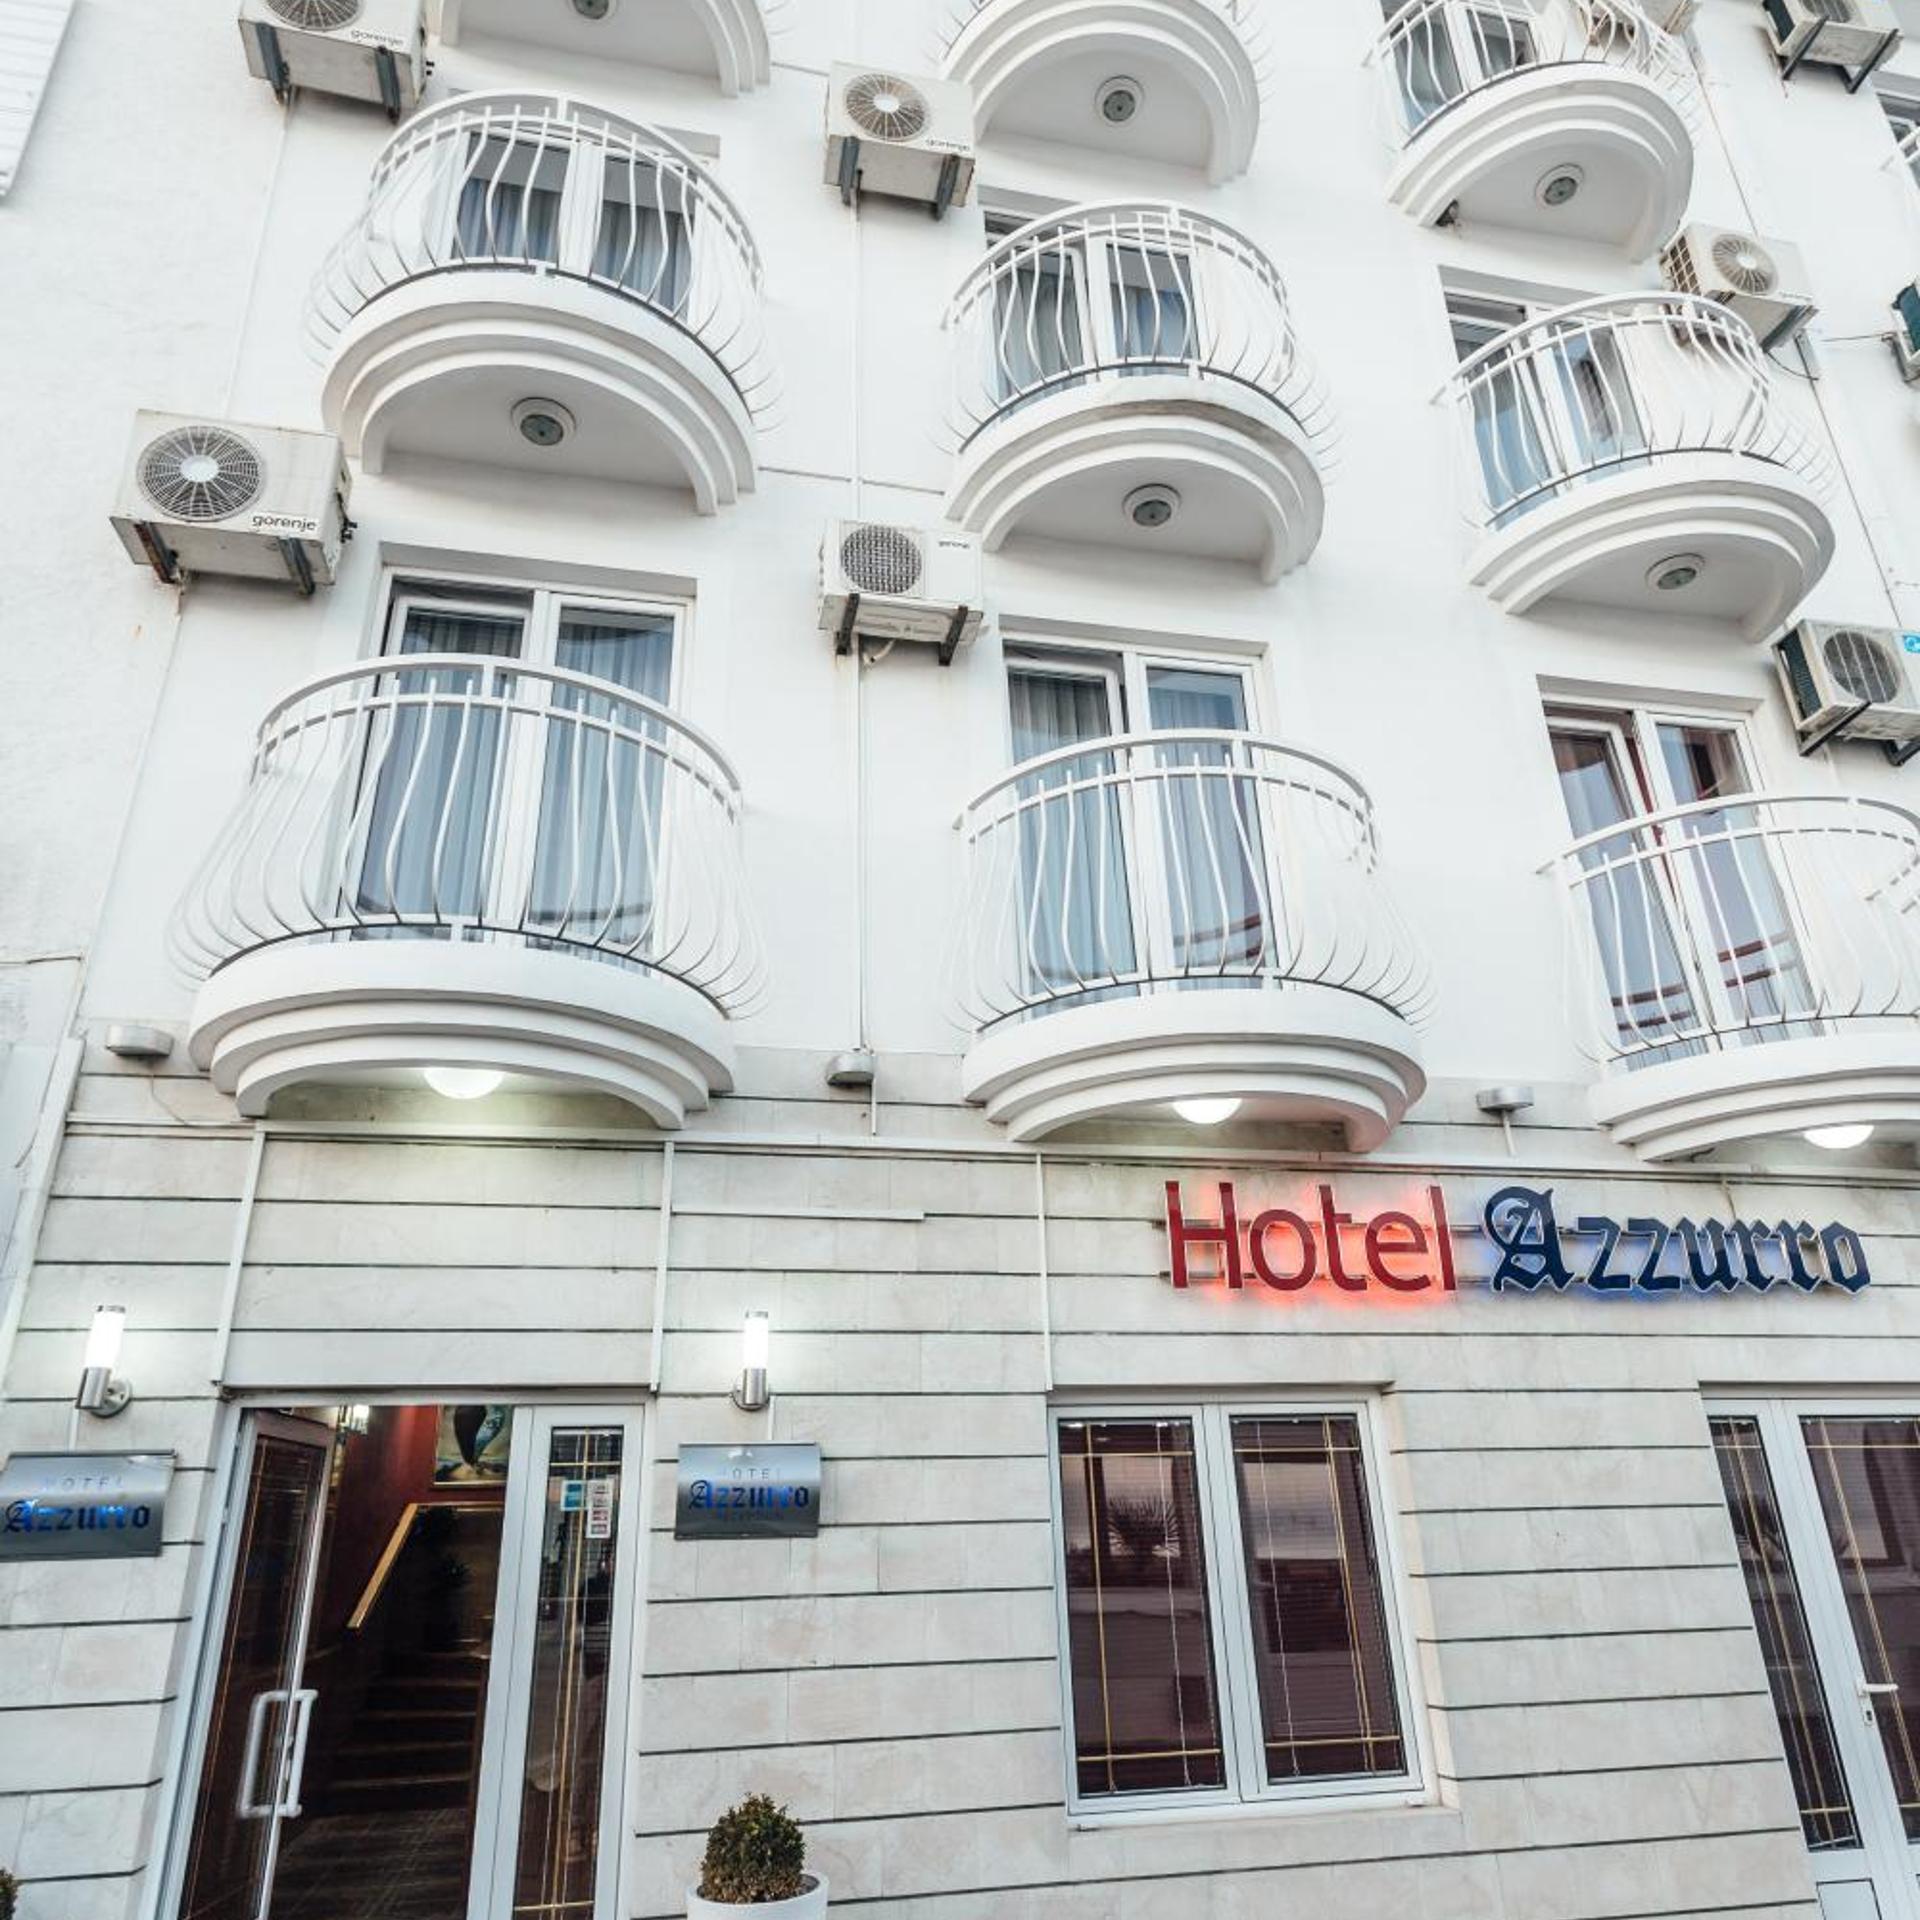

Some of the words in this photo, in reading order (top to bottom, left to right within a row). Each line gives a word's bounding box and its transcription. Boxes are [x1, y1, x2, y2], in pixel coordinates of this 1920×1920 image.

[252, 516, 316, 532] gorenje
[1165, 1180, 1456, 1291] Hotel
[1483, 1186, 1871, 1294] Azzurro
[718, 1468, 784, 1479] OTE
[688, 1480, 809, 1509] Azzurro
